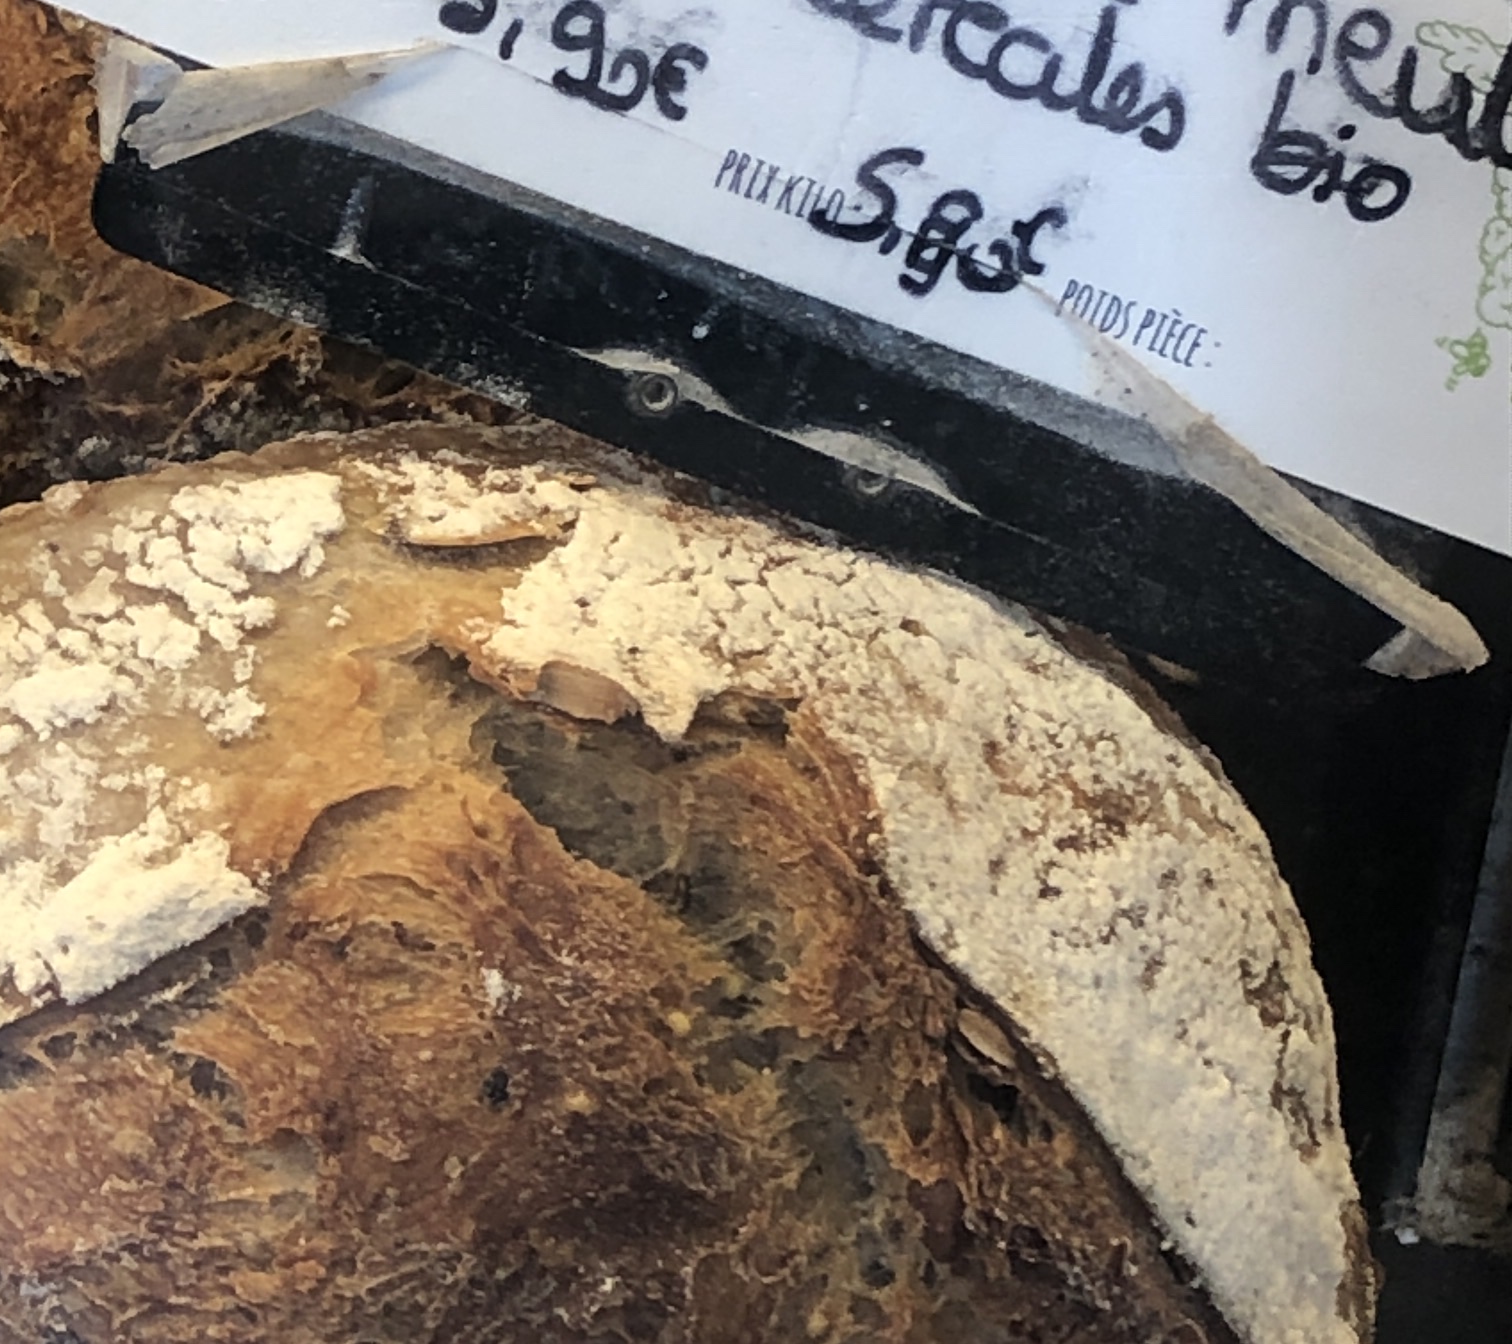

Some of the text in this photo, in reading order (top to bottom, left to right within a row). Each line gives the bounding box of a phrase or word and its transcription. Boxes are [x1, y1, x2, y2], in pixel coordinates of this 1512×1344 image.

[1251, 69, 1412, 222] bio
[713, 148, 780, 205] PRIX
[1054, 279, 1138, 340] POIDS
